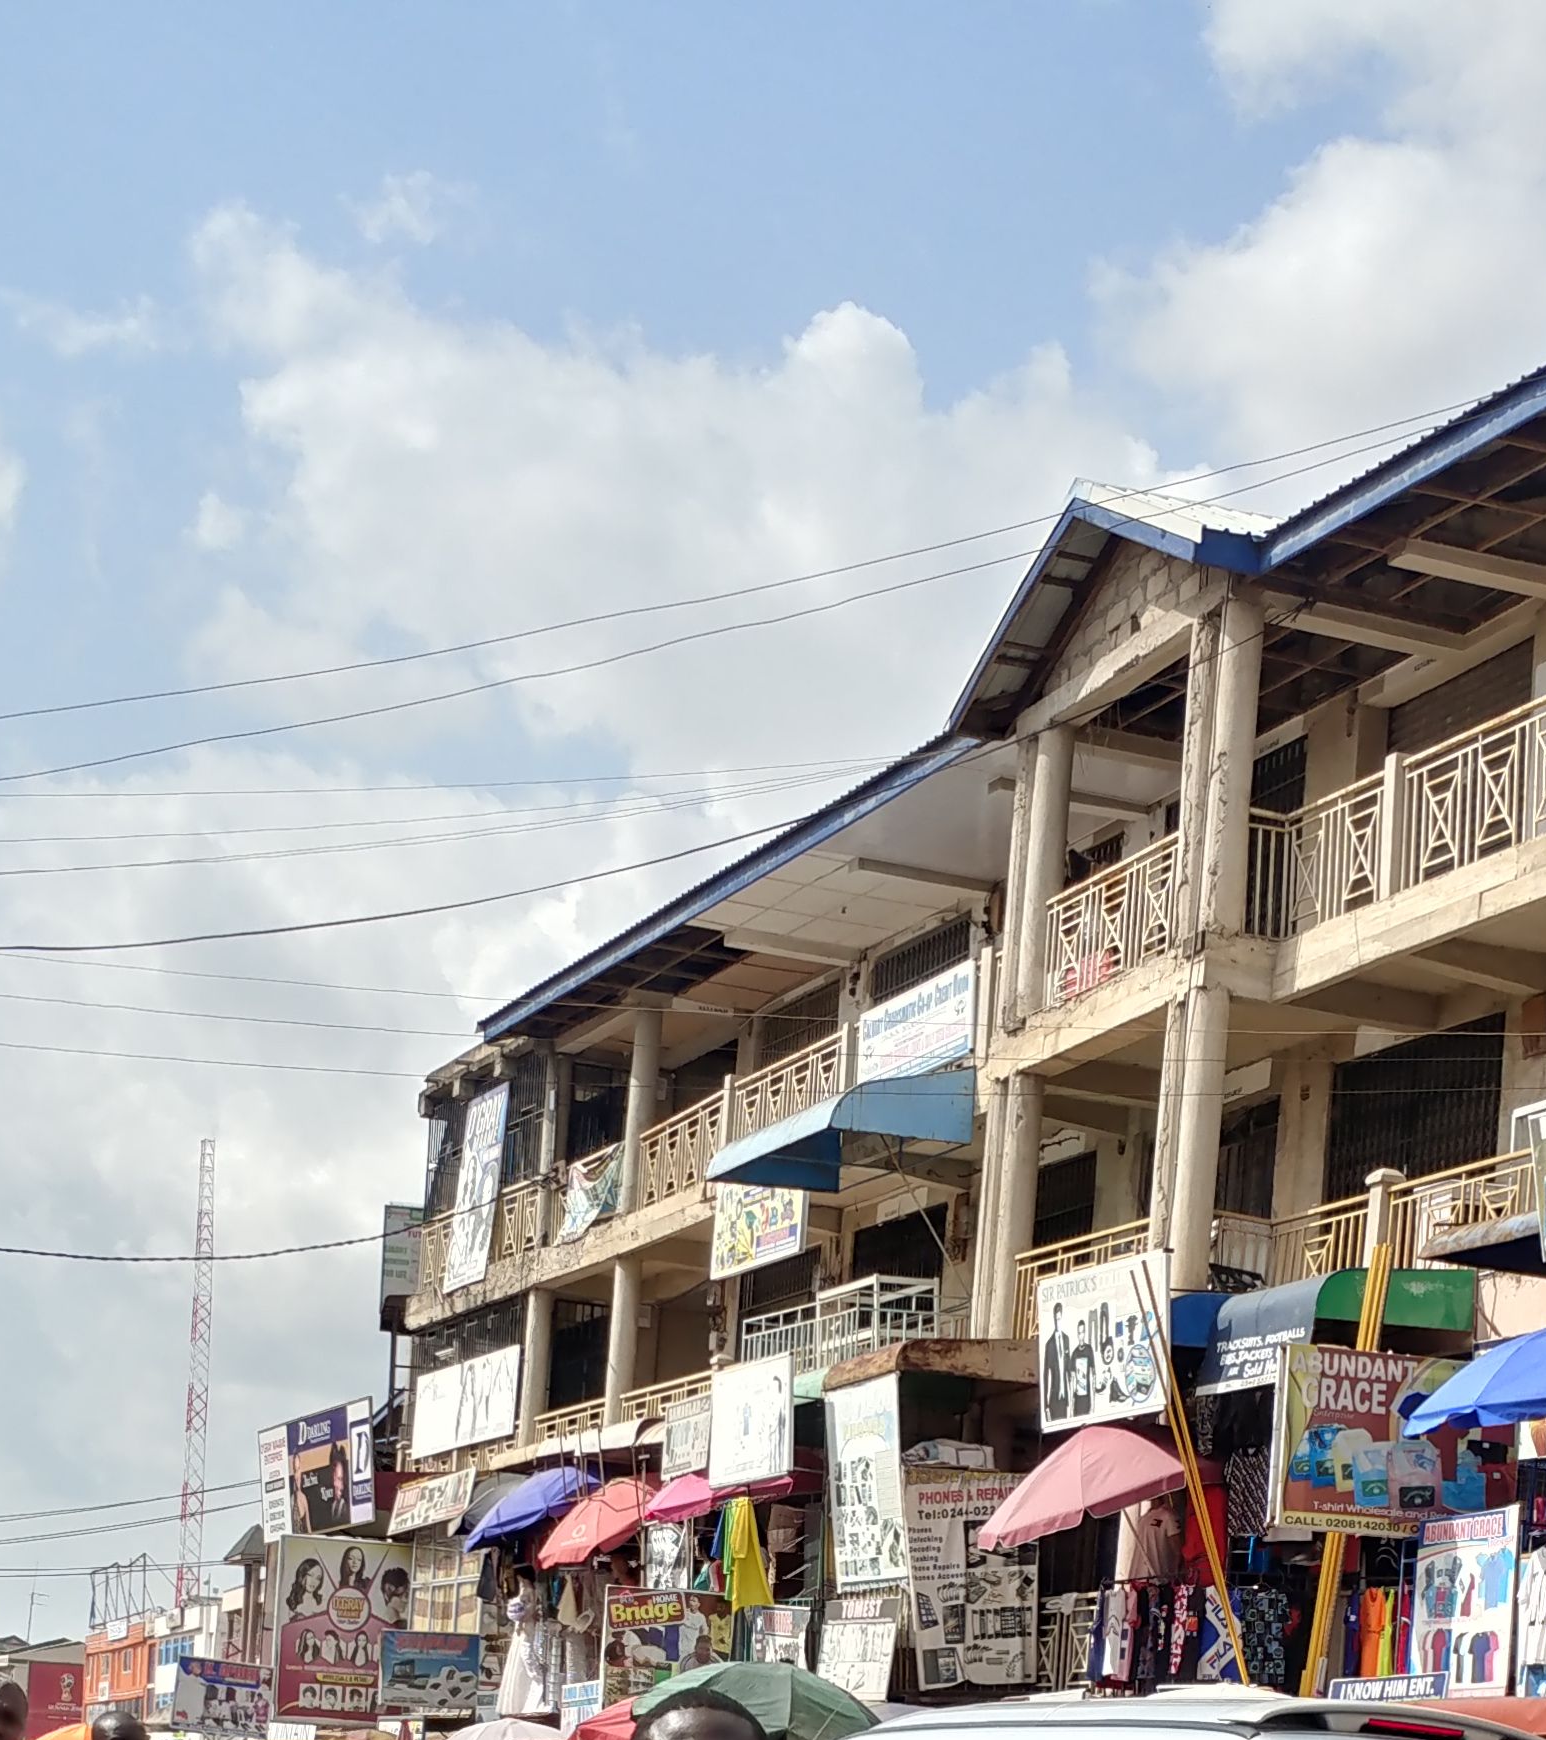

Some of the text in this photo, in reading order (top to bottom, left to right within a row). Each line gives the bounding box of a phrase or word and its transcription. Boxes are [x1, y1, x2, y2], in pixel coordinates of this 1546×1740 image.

[1265, 1327, 1306, 1346] FOOTBALLS
[1291, 1351, 1419, 1382] ABUNDANT
[1302, 1377, 1388, 1415] GRACE
[918, 1490, 964, 1506] PHONES
[1313, 1500, 1344, 1513] T-shirt
[1345, 1503, 1404, 1519] Wholesale
[1405, 1509, 1428, 1520] and
[1284, 1515, 1323, 1528] CALL:
[1325, 1517, 1401, 1533] 0208142030
[1423, 1519, 1473, 1545] ABUNDANT
[1473, 1514, 1503, 1541] GRACE
[652, 1593, 679, 1604] HOME
[611, 1599, 682, 1623] Bridge
[841, 1599, 883, 1619] TOMEST
[1347, 1681, 1382, 1700] KNOW
[1383, 1679, 1408, 1698] HIM
[1409, 1677, 1435, 1696] ENT.
